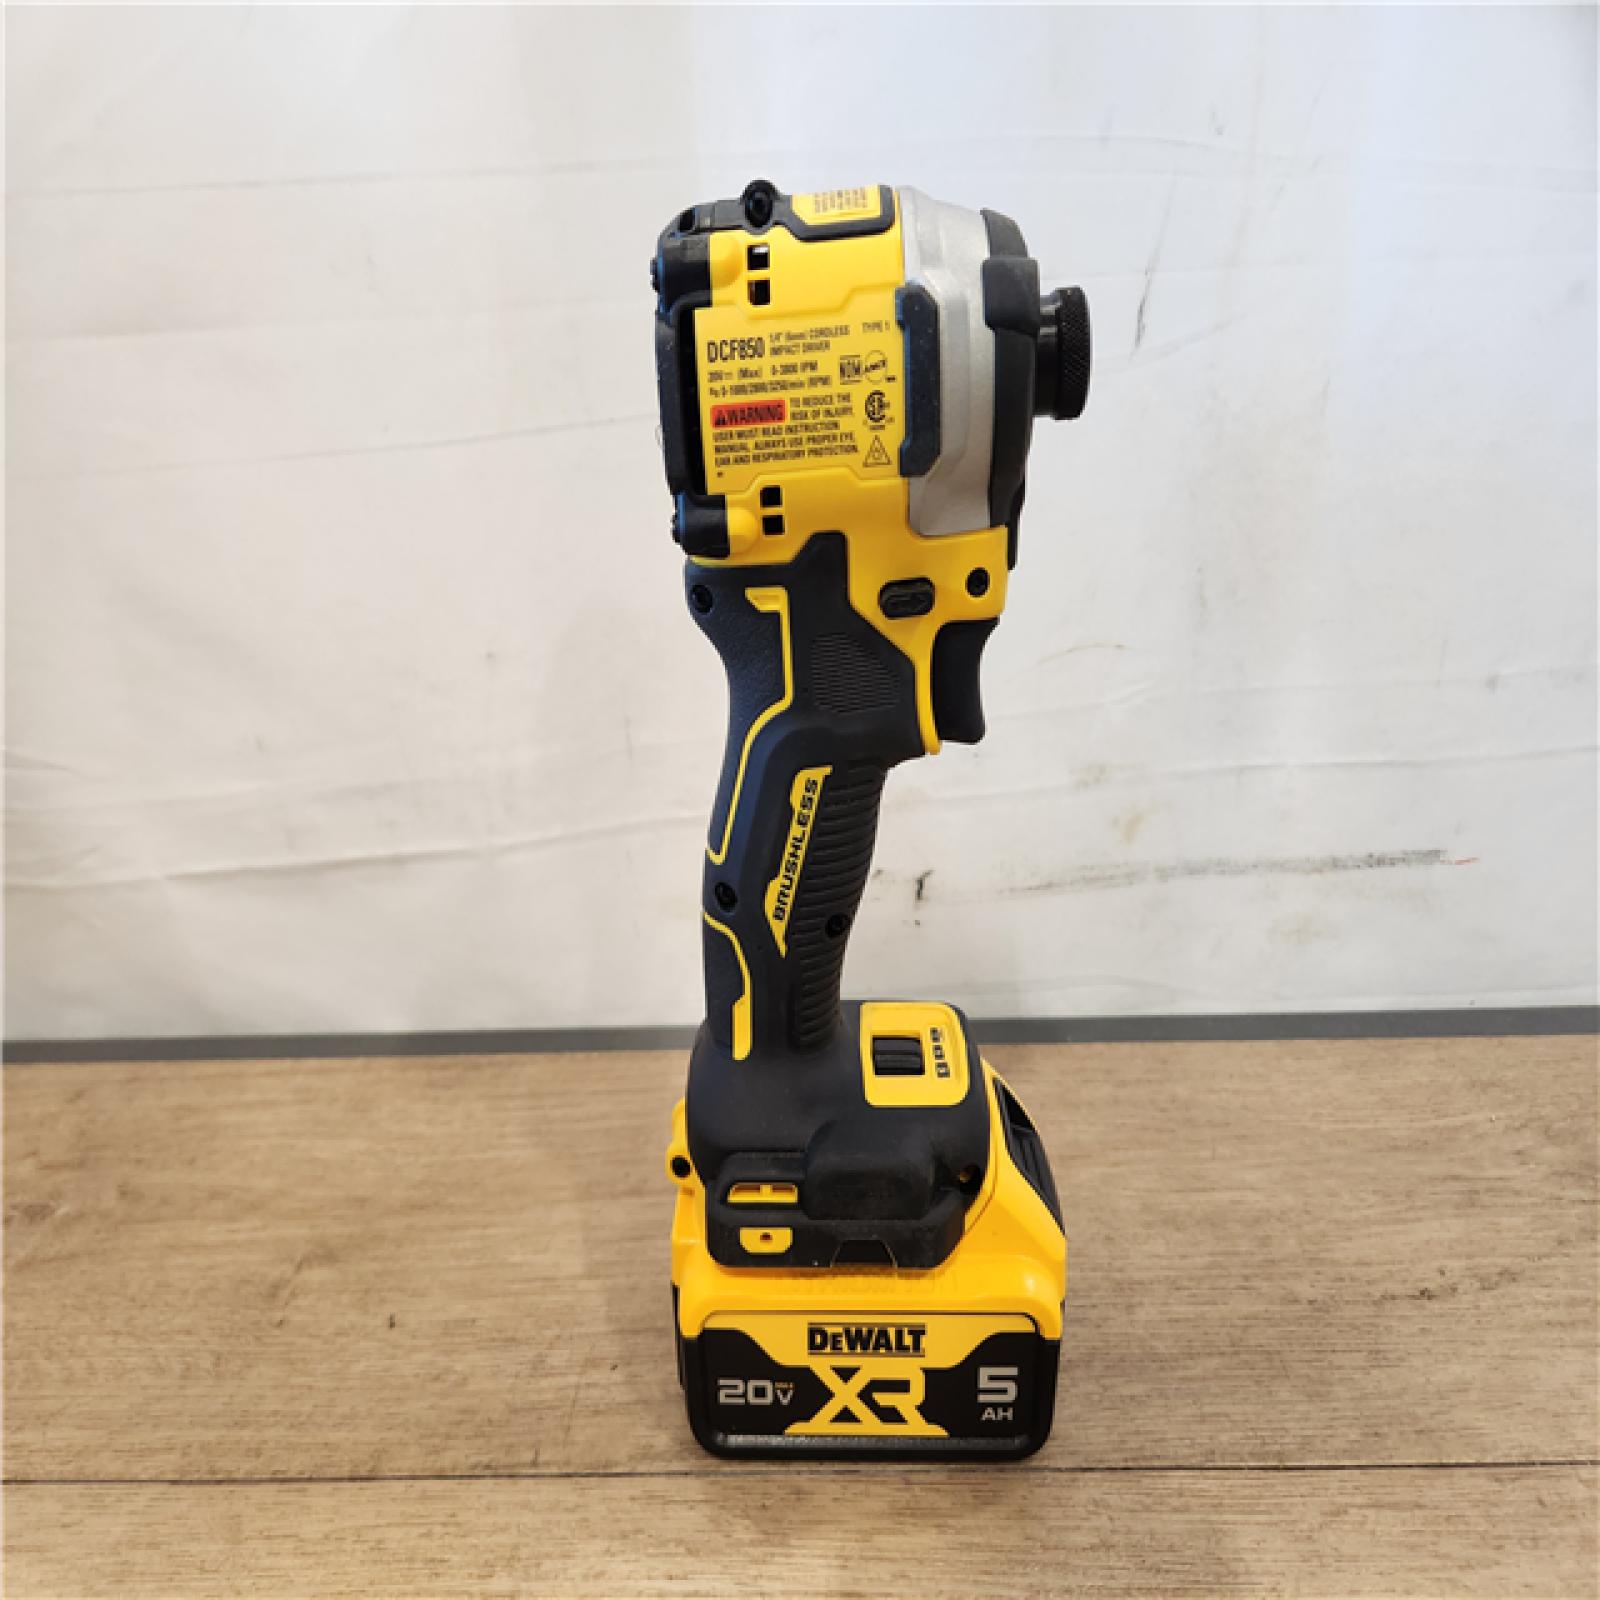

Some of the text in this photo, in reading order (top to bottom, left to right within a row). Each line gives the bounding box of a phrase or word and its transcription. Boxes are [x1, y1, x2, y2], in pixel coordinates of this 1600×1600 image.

[706, 337, 765, 363] DCF850
[769, 339, 831, 356] IMPACT DRIVER
[789, 392, 851, 408] TO REDUCE THE
[727, 403, 784, 425] WARNING
[789, 410, 808, 421] RISK
[713, 420, 839, 442] USER MUST READ INSTRUCTION
[754, 438, 787, 451] ALWAYS
[787, 437, 804, 448] USE
[807, 433, 838, 445] PROPER
[715, 456, 731, 468] EAR
[732, 454, 751, 466] AND
[773, 777, 818, 921] BRUSHLESS
[977, 1366, 1018, 1402] 5
[784, 1364, 948, 1436] XR
[981, 1407, 1013, 1420] AH
